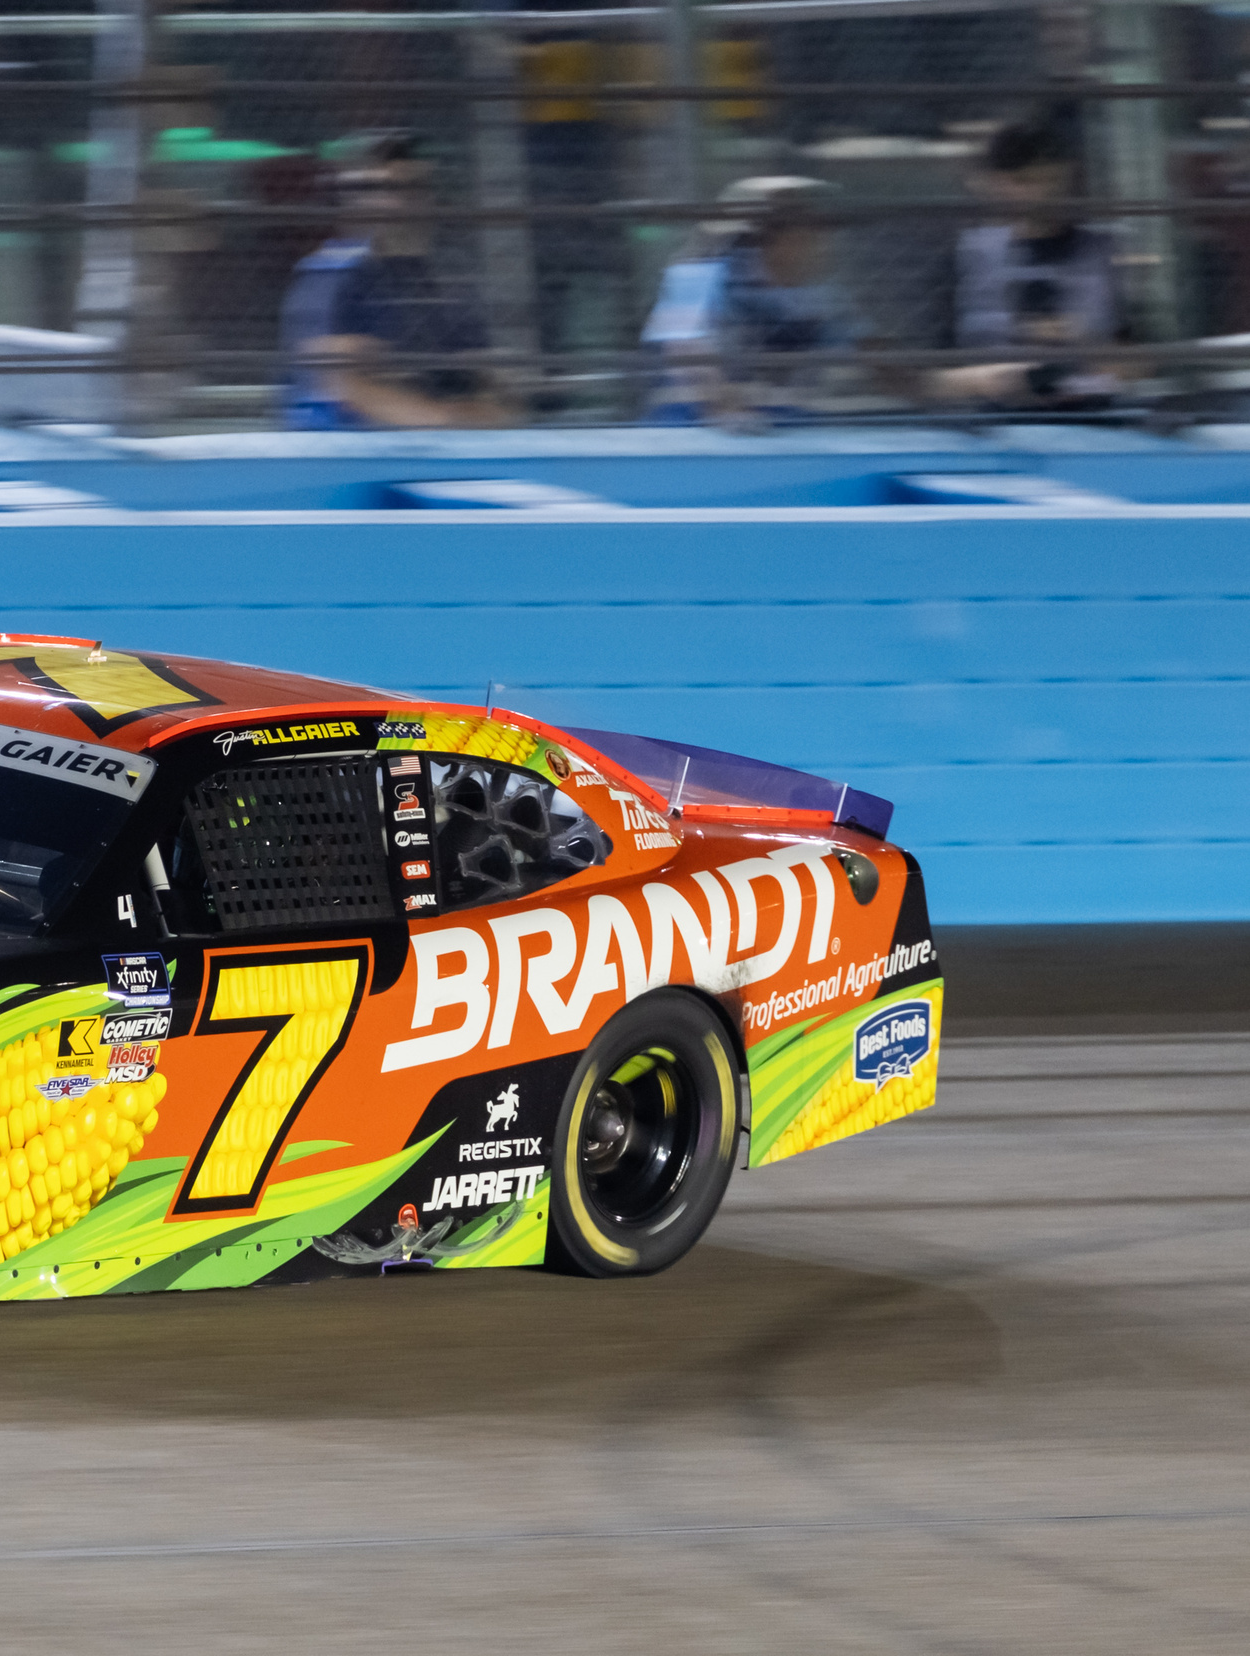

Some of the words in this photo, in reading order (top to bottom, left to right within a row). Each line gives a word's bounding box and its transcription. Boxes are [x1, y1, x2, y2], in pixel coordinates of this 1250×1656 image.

[213, 730, 265, 755] Justin
[253, 722, 360, 745] ALLGAIER
[609, 791, 670, 831] Tufco
[634, 832, 679, 851] FLOORING
[406, 864, 427, 876] SEM
[117, 894, 137, 928] 4
[380, 842, 838, 1073] BRANDT
[116, 966, 157, 989] xfinity
[742, 966, 842, 1031] Professional
[843, 939, 931, 998] Agriculture
[103, 1017, 169, 1039] COMETIC
[859, 1025, 889, 1061] Best
[891, 1014, 926, 1043] Foods
[56, 1058, 95, 1069] KENNAMETAL
[110, 1043, 158, 1068] Holley
[105, 1065, 150, 1084] MSD
[172, 945, 369, 1215] 7
[459, 1137, 542, 1162] REGISTIX
[422, 1165, 545, 1212] JARRETT
